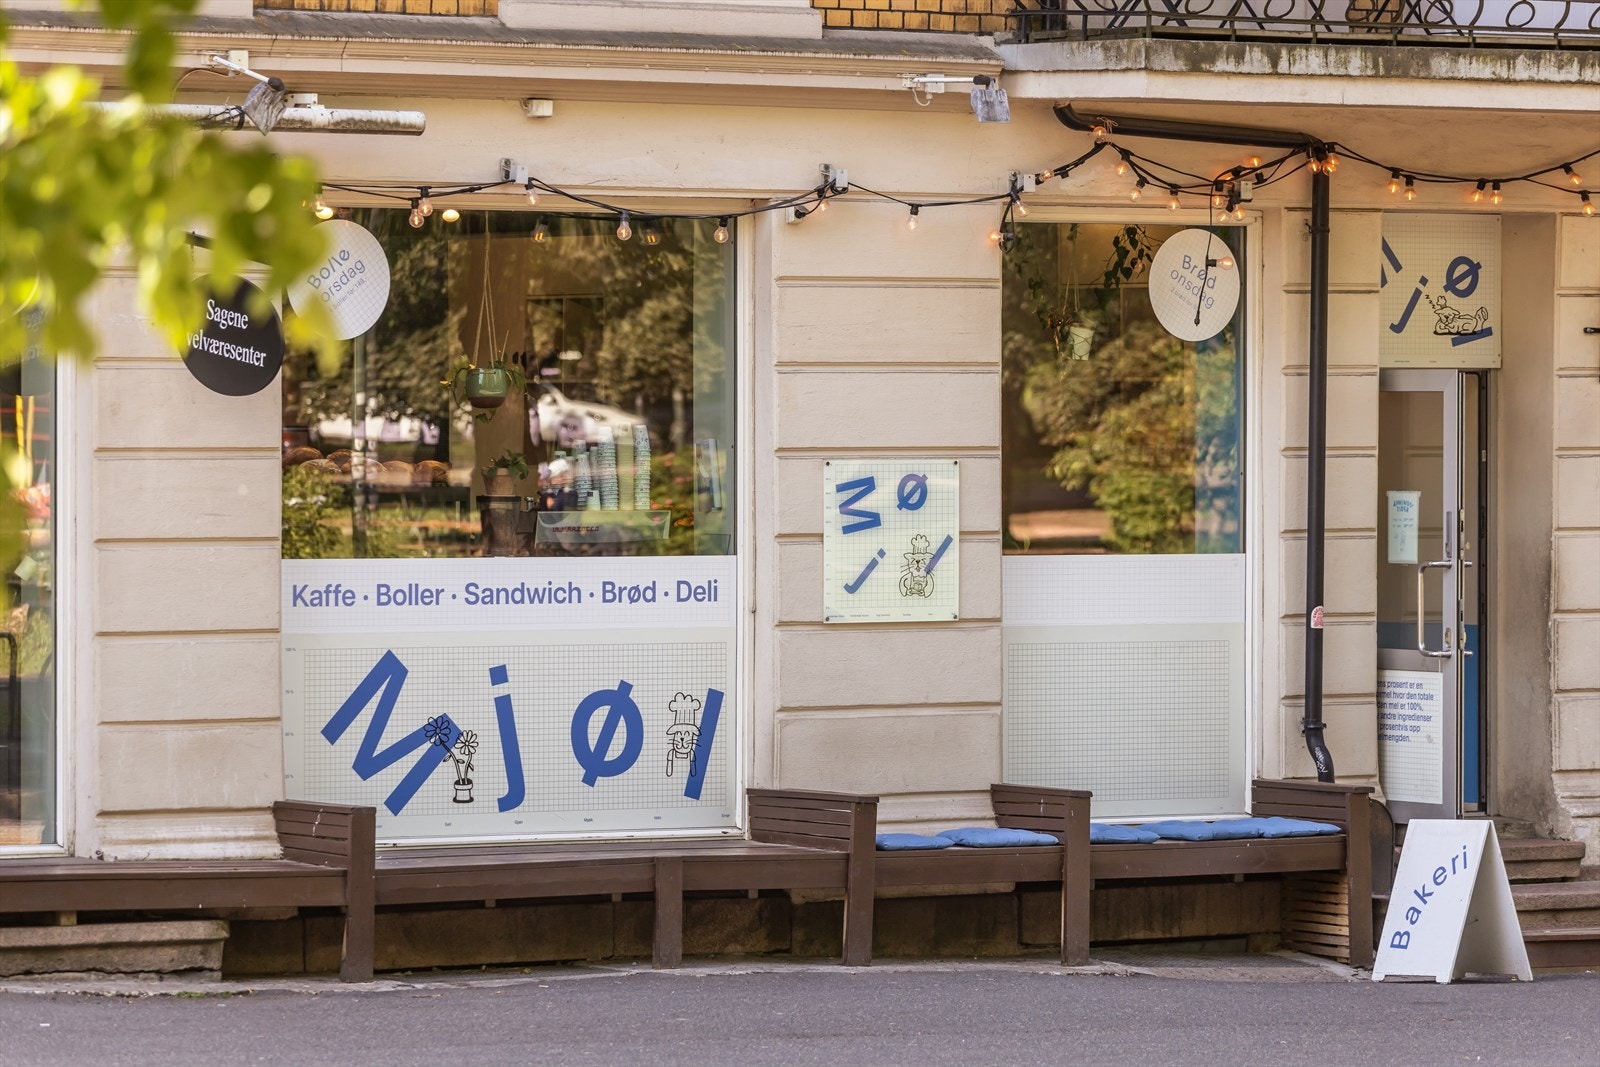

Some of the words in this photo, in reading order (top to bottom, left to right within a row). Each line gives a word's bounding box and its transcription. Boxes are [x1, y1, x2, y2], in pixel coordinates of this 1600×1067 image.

[306, 249, 350, 290] Bolle
[320, 259, 366, 303] orsdag
[1182, 254, 1217, 290] Brød
[1170, 269, 1215, 310] onsdag
[206, 299, 249, 330] Sagene
[186, 329, 267, 368] velværesenter
[292, 583, 356, 608] Kaffe
[376, 582, 445, 607] Boller
[464, 581, 582, 605] Sandwich
[602, 580, 657, 605] Brød
[676, 578, 718, 603] Deli
[1387, 680, 1409, 689] prosent
[1416, 682, 1424, 690] en
[1393, 690, 1405, 699] hvor
[1406, 691, 1417, 700] den
[1417, 692, 1434, 701] totale
[1380, 711, 1397, 720] andre
[1398, 712, 1432, 723] ingredienser
[1389, 702, 1399, 710] mel
[321, 649, 725, 817] Mjøl
[1380, 723, 1408, 732] prosentvis
[1409, 725, 1421, 734] opp
[1389, 845, 1468, 950] Bakeri
